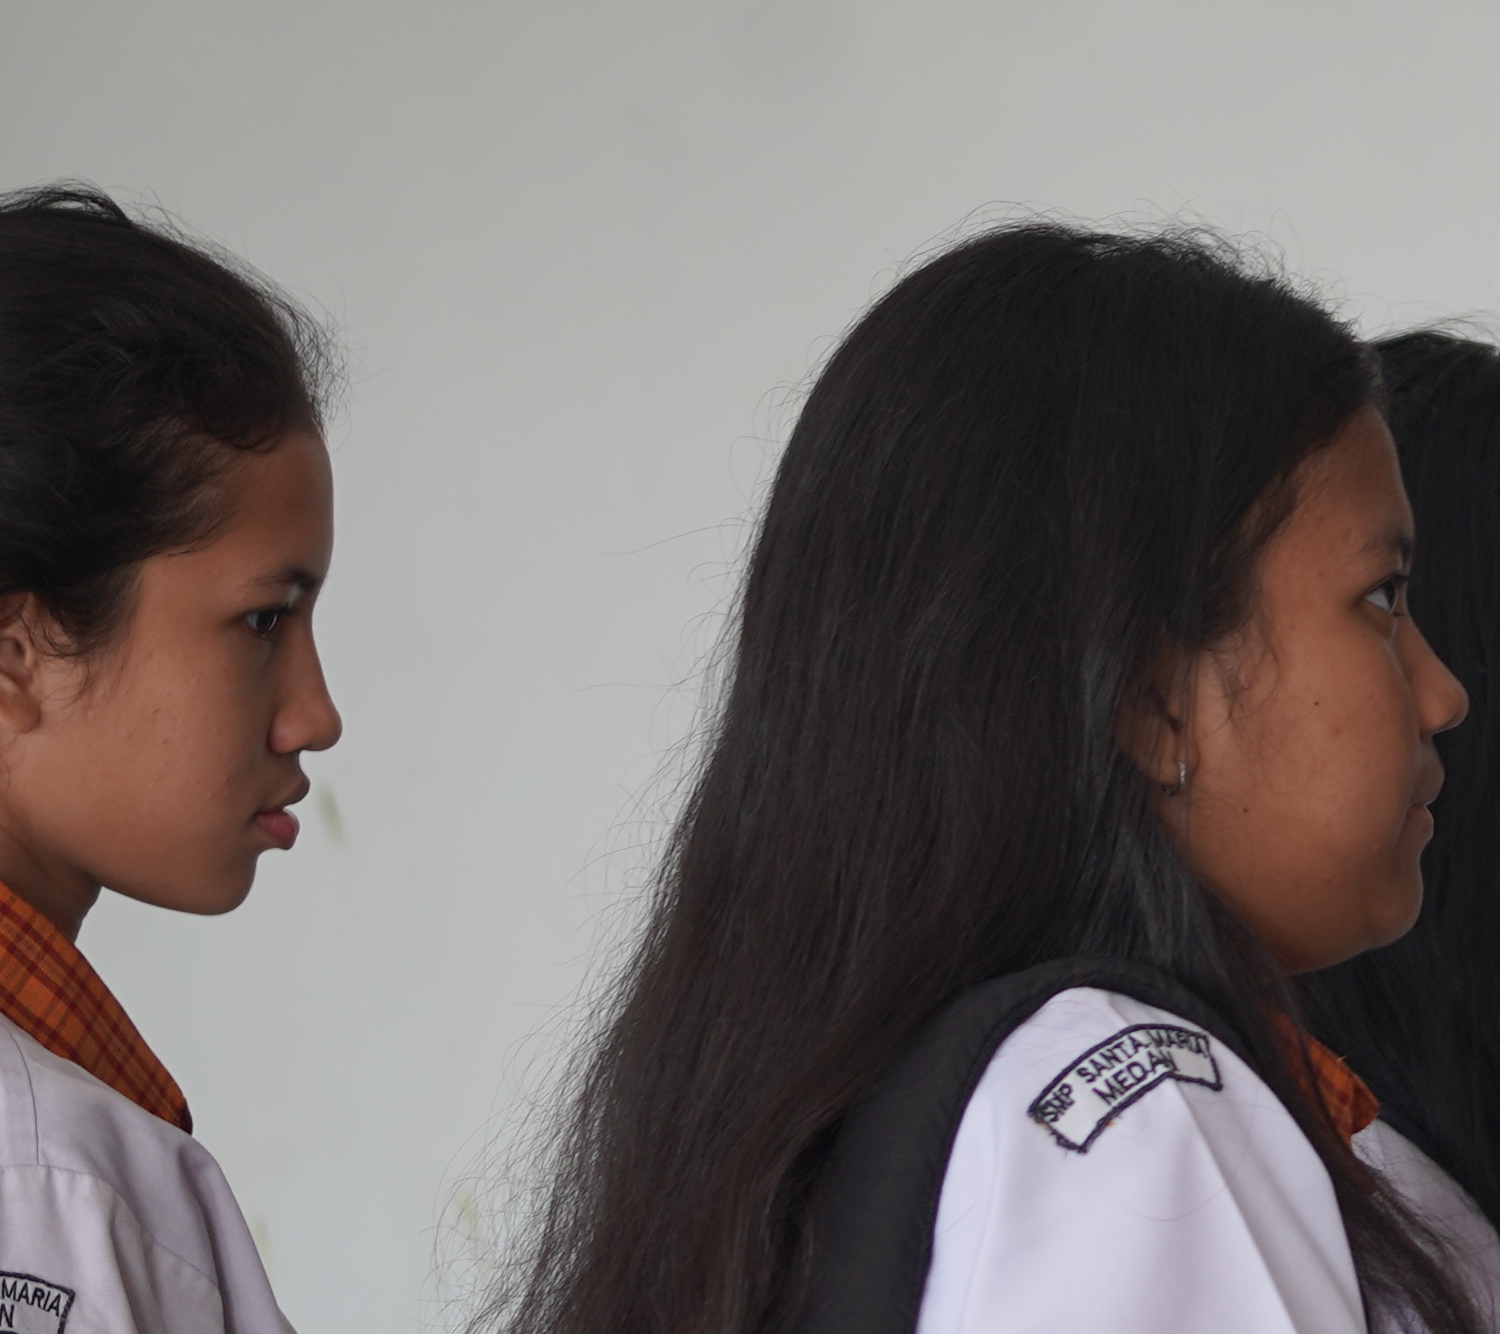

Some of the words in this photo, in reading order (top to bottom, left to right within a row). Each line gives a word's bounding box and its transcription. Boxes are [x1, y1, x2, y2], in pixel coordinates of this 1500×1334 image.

[1040, 1083, 1076, 1123] SMP
[1076, 1035, 1146, 1084] SANTA
[1092, 1048, 1181, 1106] MEDAN
[1, 1278, 62, 1317] MARIA
